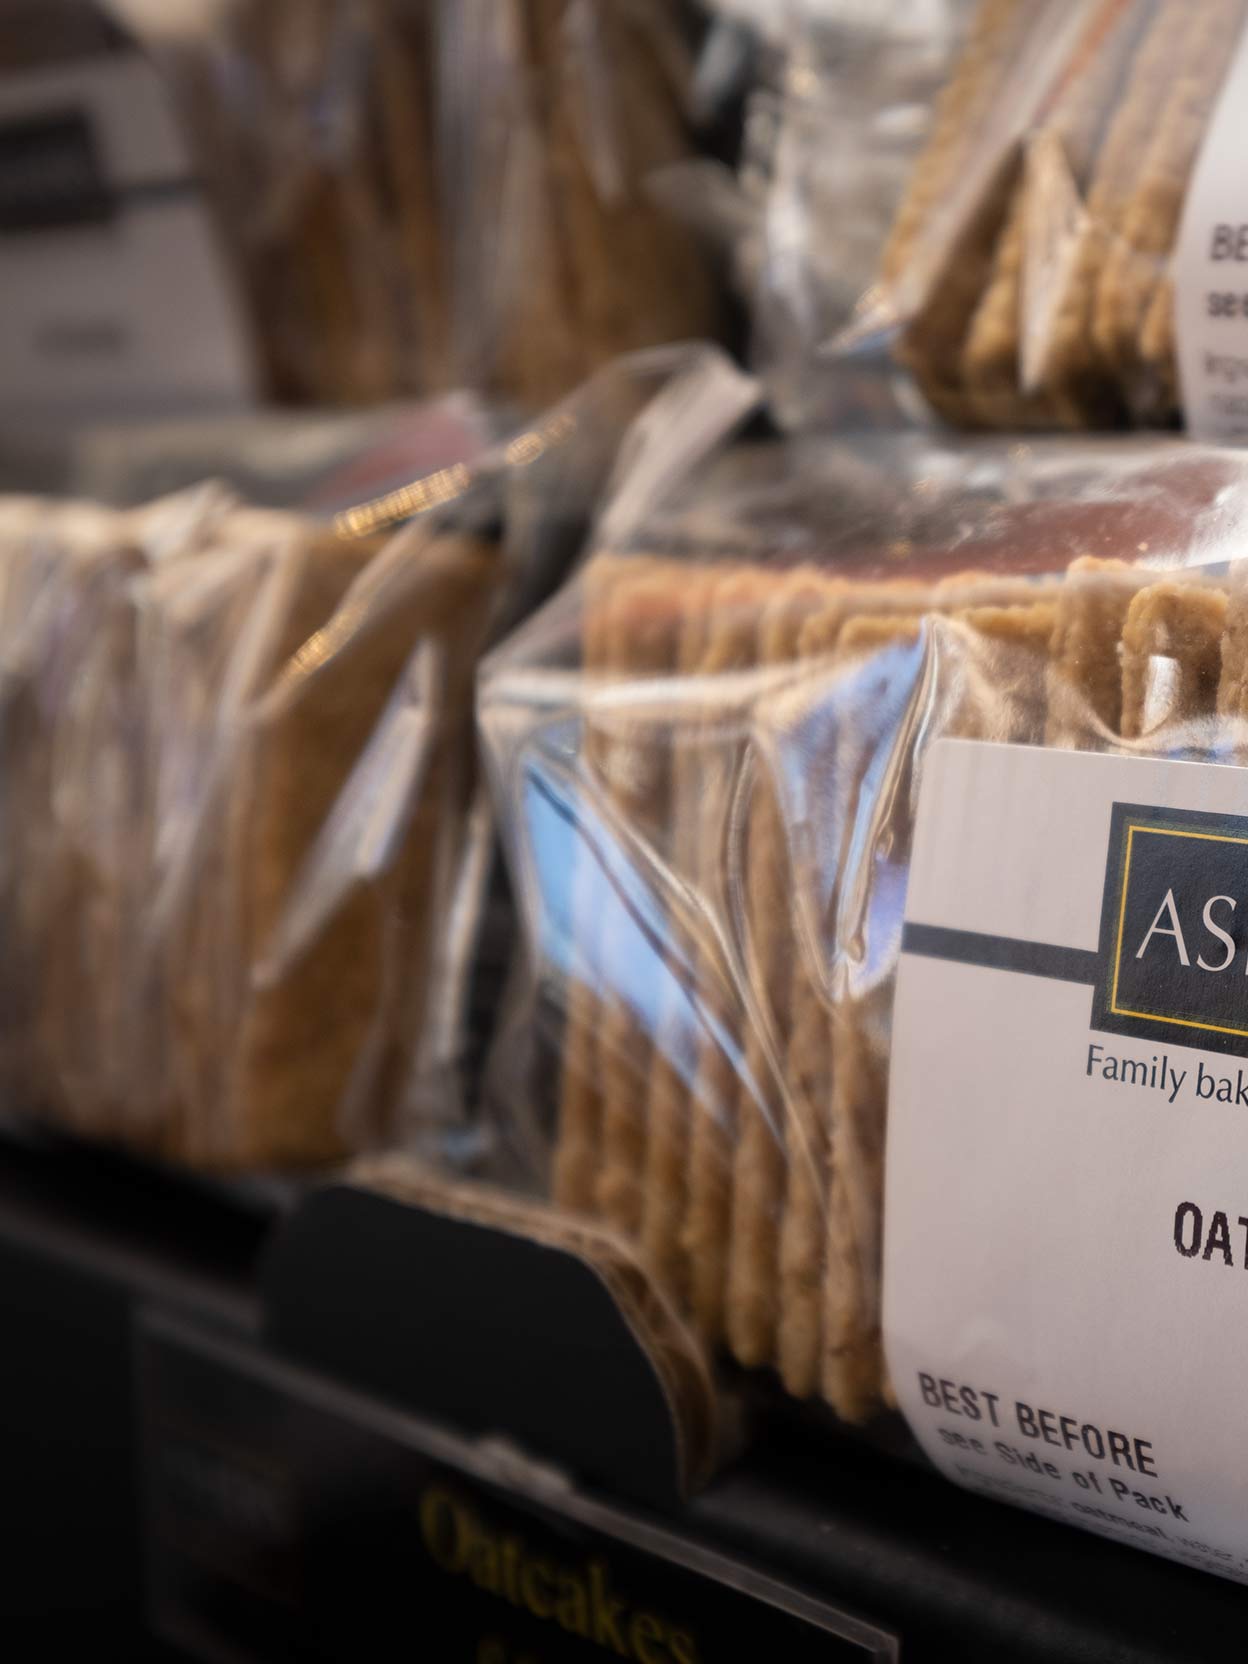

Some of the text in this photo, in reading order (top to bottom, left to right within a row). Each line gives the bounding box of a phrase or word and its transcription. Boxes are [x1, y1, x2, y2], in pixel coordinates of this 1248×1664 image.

[1086, 1043, 1187, 1104] Family
[917, 1371, 1159, 1479] BEST BEFORE
[937, 1427, 988, 1457] see
[994, 1439, 1062, 1481] Side
[1072, 1470, 1103, 1495] of
[1108, 1476, 1191, 1523] Pack
[418, 1484, 705, 1664] Oatcakes
